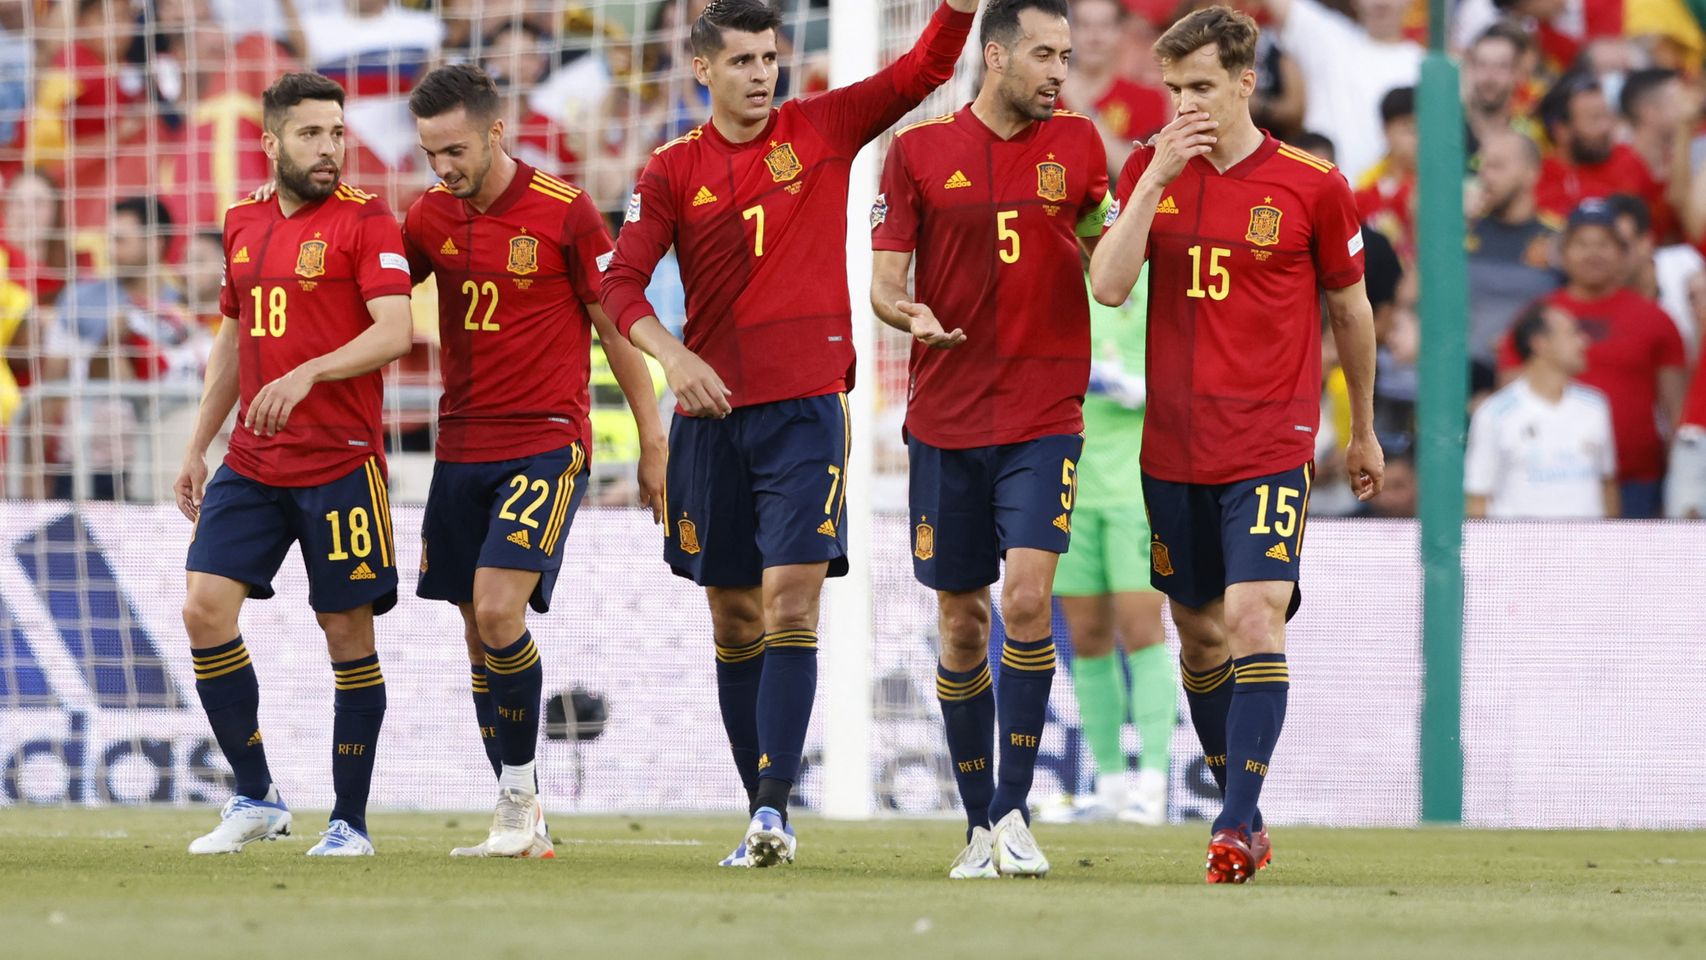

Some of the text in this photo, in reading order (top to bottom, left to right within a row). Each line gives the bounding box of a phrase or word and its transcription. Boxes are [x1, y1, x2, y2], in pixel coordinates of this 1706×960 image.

[692, 195, 718, 207] adidas
[944, 180, 972, 189] adidas
[742, 205, 764, 256] 7
[997, 211, 1020, 263] 5
[1187, 246, 1231, 300] 15
[251, 286, 286, 337] 18
[462, 281, 500, 331] 22
[499, 474, 550, 529] 22
[824, 464, 840, 515] 7
[1060, 457, 1076, 510] 5
[326, 506, 372, 561] 18
[1250, 485, 1300, 538] 15
[506, 534, 532, 550] adidas
[1265, 551, 1290, 563] adidas
[350, 572, 376, 580] adidas
[338, 743, 366, 756] RFEF
[958, 757, 985, 773] RFEF
[1010, 733, 1038, 748] RFEF
